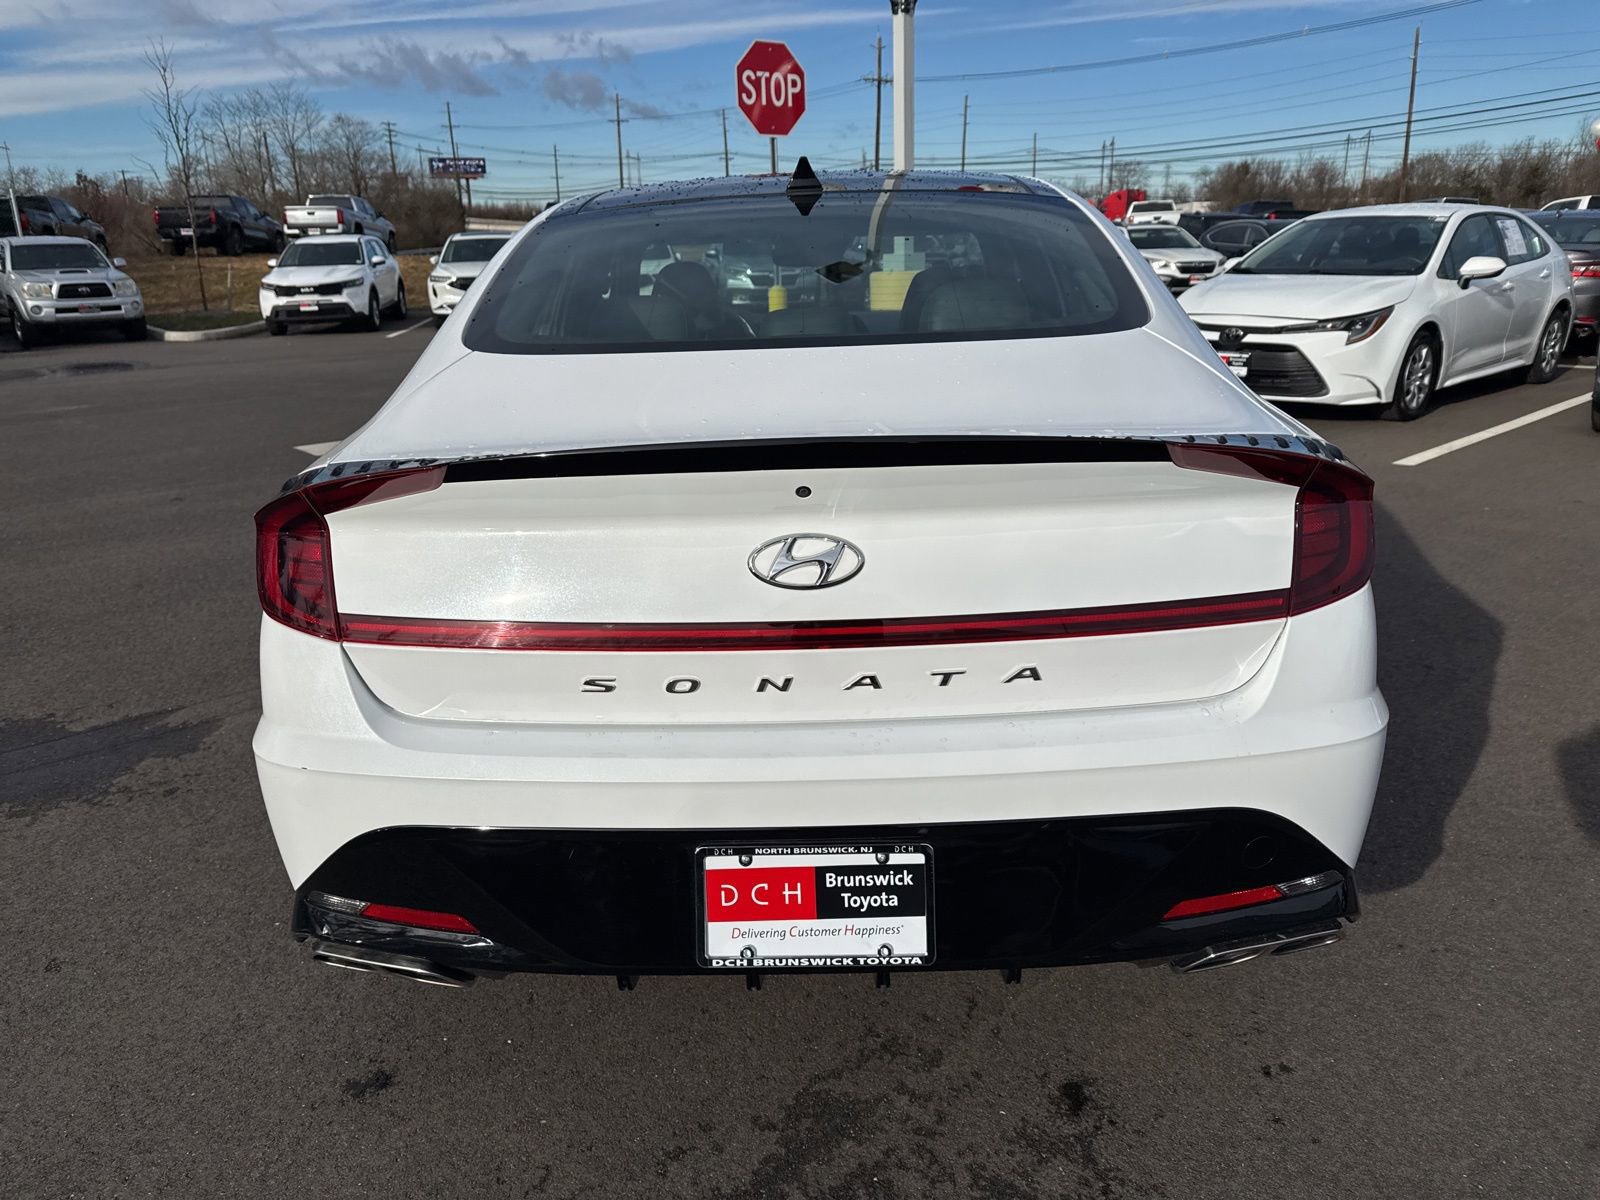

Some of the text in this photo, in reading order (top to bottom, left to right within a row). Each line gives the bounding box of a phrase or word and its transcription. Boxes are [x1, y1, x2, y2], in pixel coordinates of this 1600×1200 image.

[741, 69, 802, 108] STOP
[581, 662, 1044, 695] SONATA
[755, 847, 791, 855] NORTH
[825, 869, 914, 888] Brunswick
[720, 882, 802, 907] DCH
[841, 892, 898, 912] Toyota
[731, 927, 786, 940] Delivering
[789, 926, 841, 938] Customer
[712, 956, 923, 967] DCH BRUNSWICK TOYOTA
